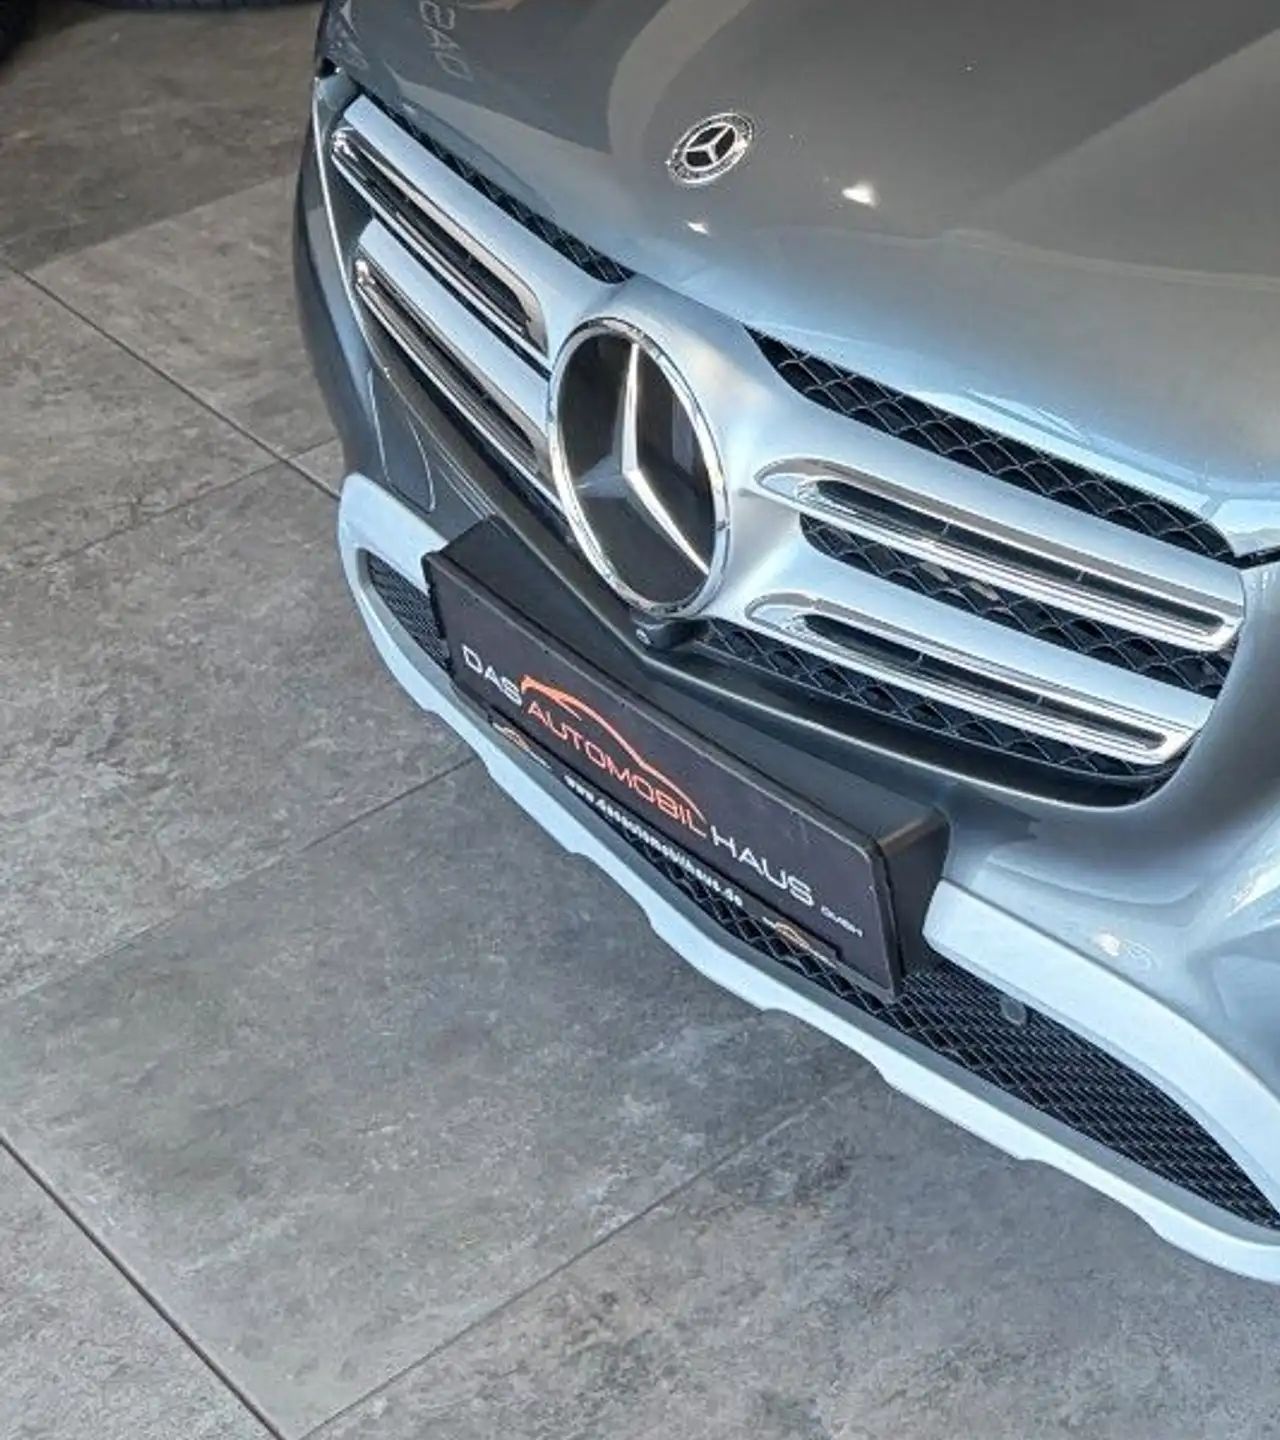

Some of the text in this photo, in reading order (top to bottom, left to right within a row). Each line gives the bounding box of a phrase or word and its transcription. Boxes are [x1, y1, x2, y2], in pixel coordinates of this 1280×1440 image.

[461, 643, 523, 708] DAS
[527, 699, 708, 839] AUTOMOBIL
[710, 824, 815, 908] HAUS
